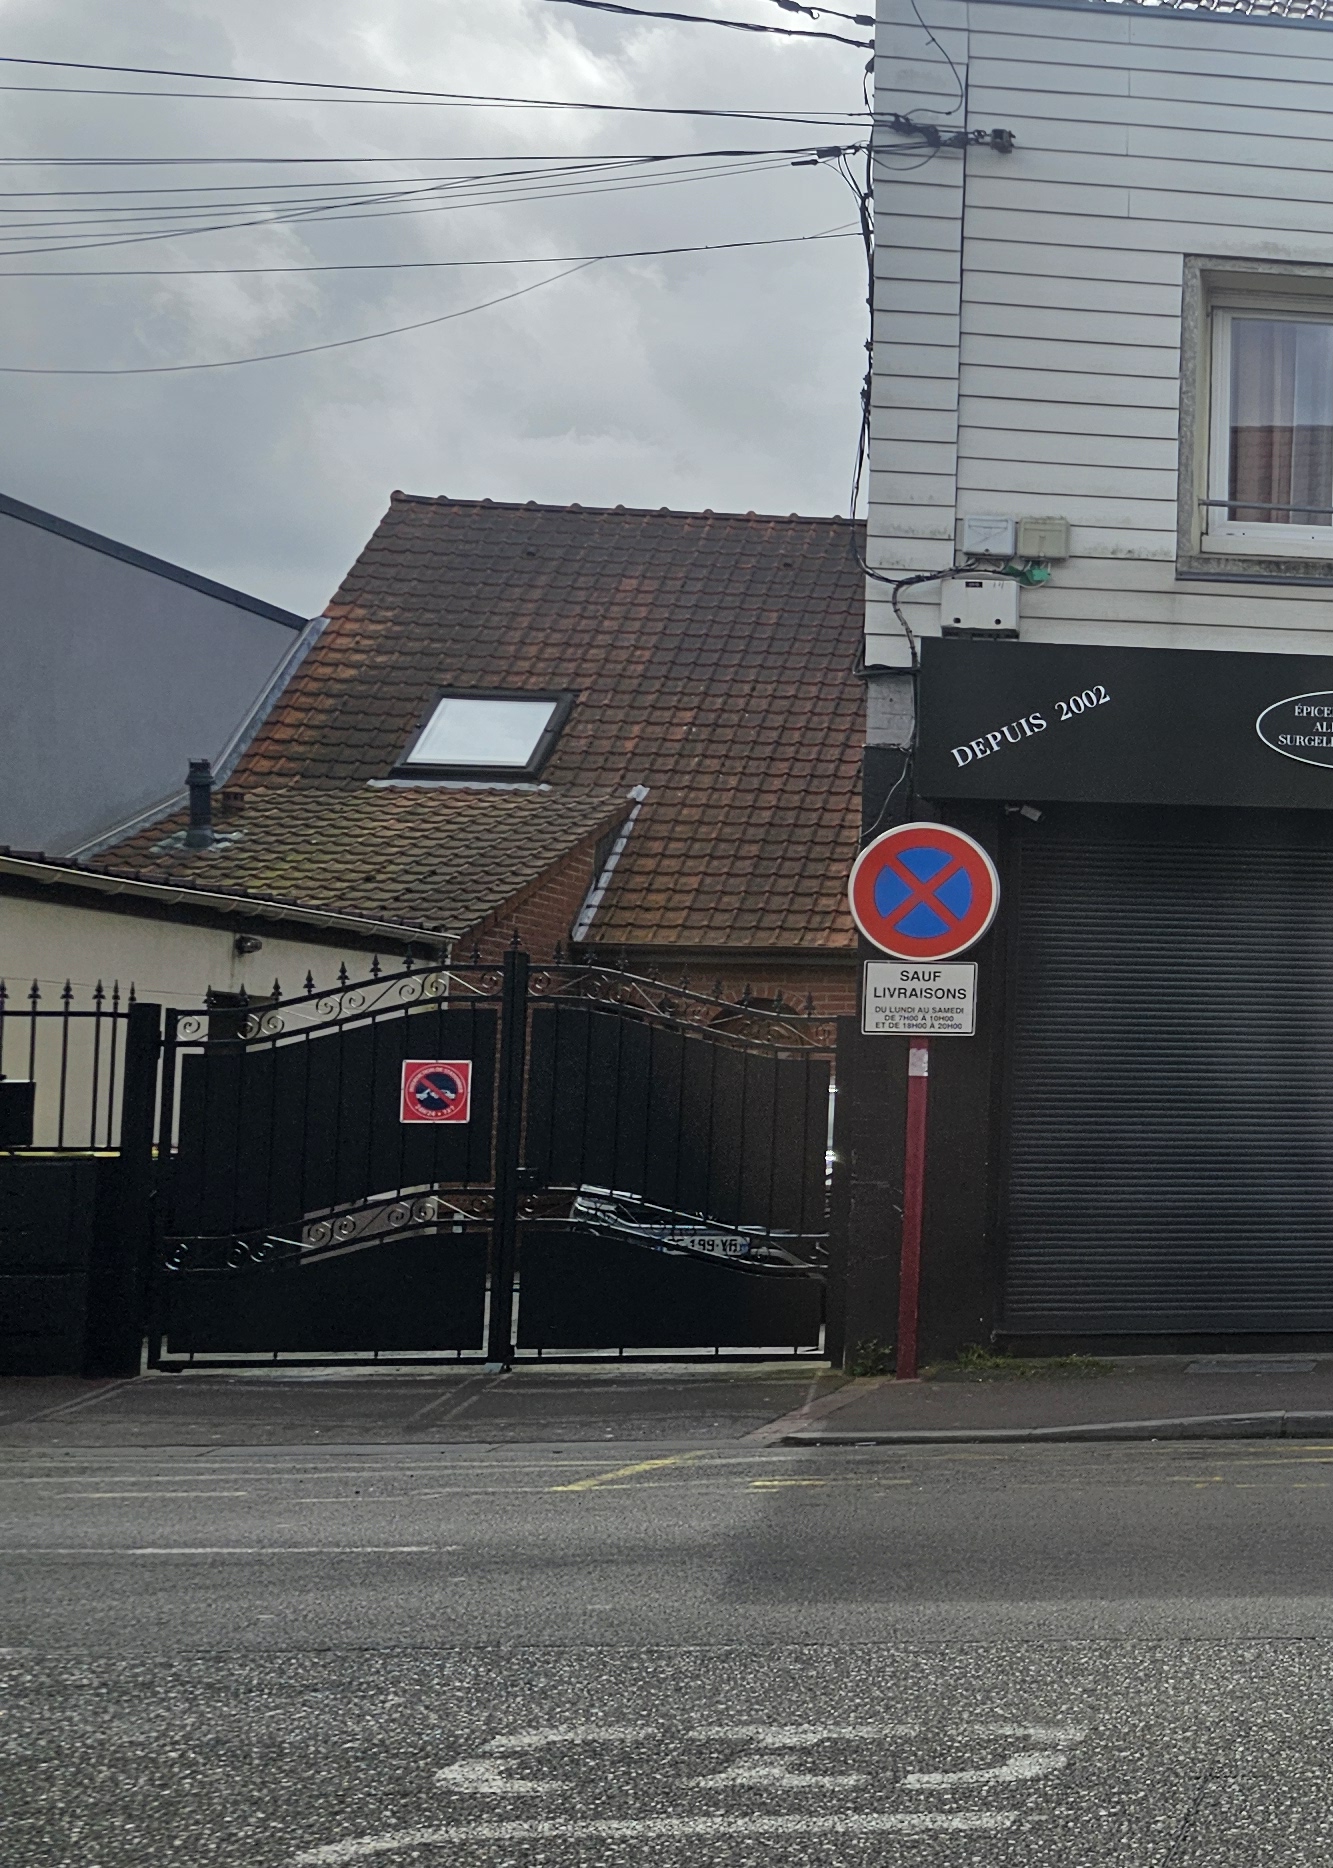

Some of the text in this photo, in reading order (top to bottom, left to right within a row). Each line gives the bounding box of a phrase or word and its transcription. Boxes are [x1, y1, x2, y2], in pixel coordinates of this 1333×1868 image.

[950, 685, 1111, 768] DEPUIS 2002
[900, 970, 942, 982] SAUF
[874, 987, 967, 1000] LIVRAISONS
[889, 1006, 916, 1014] LUNDI
